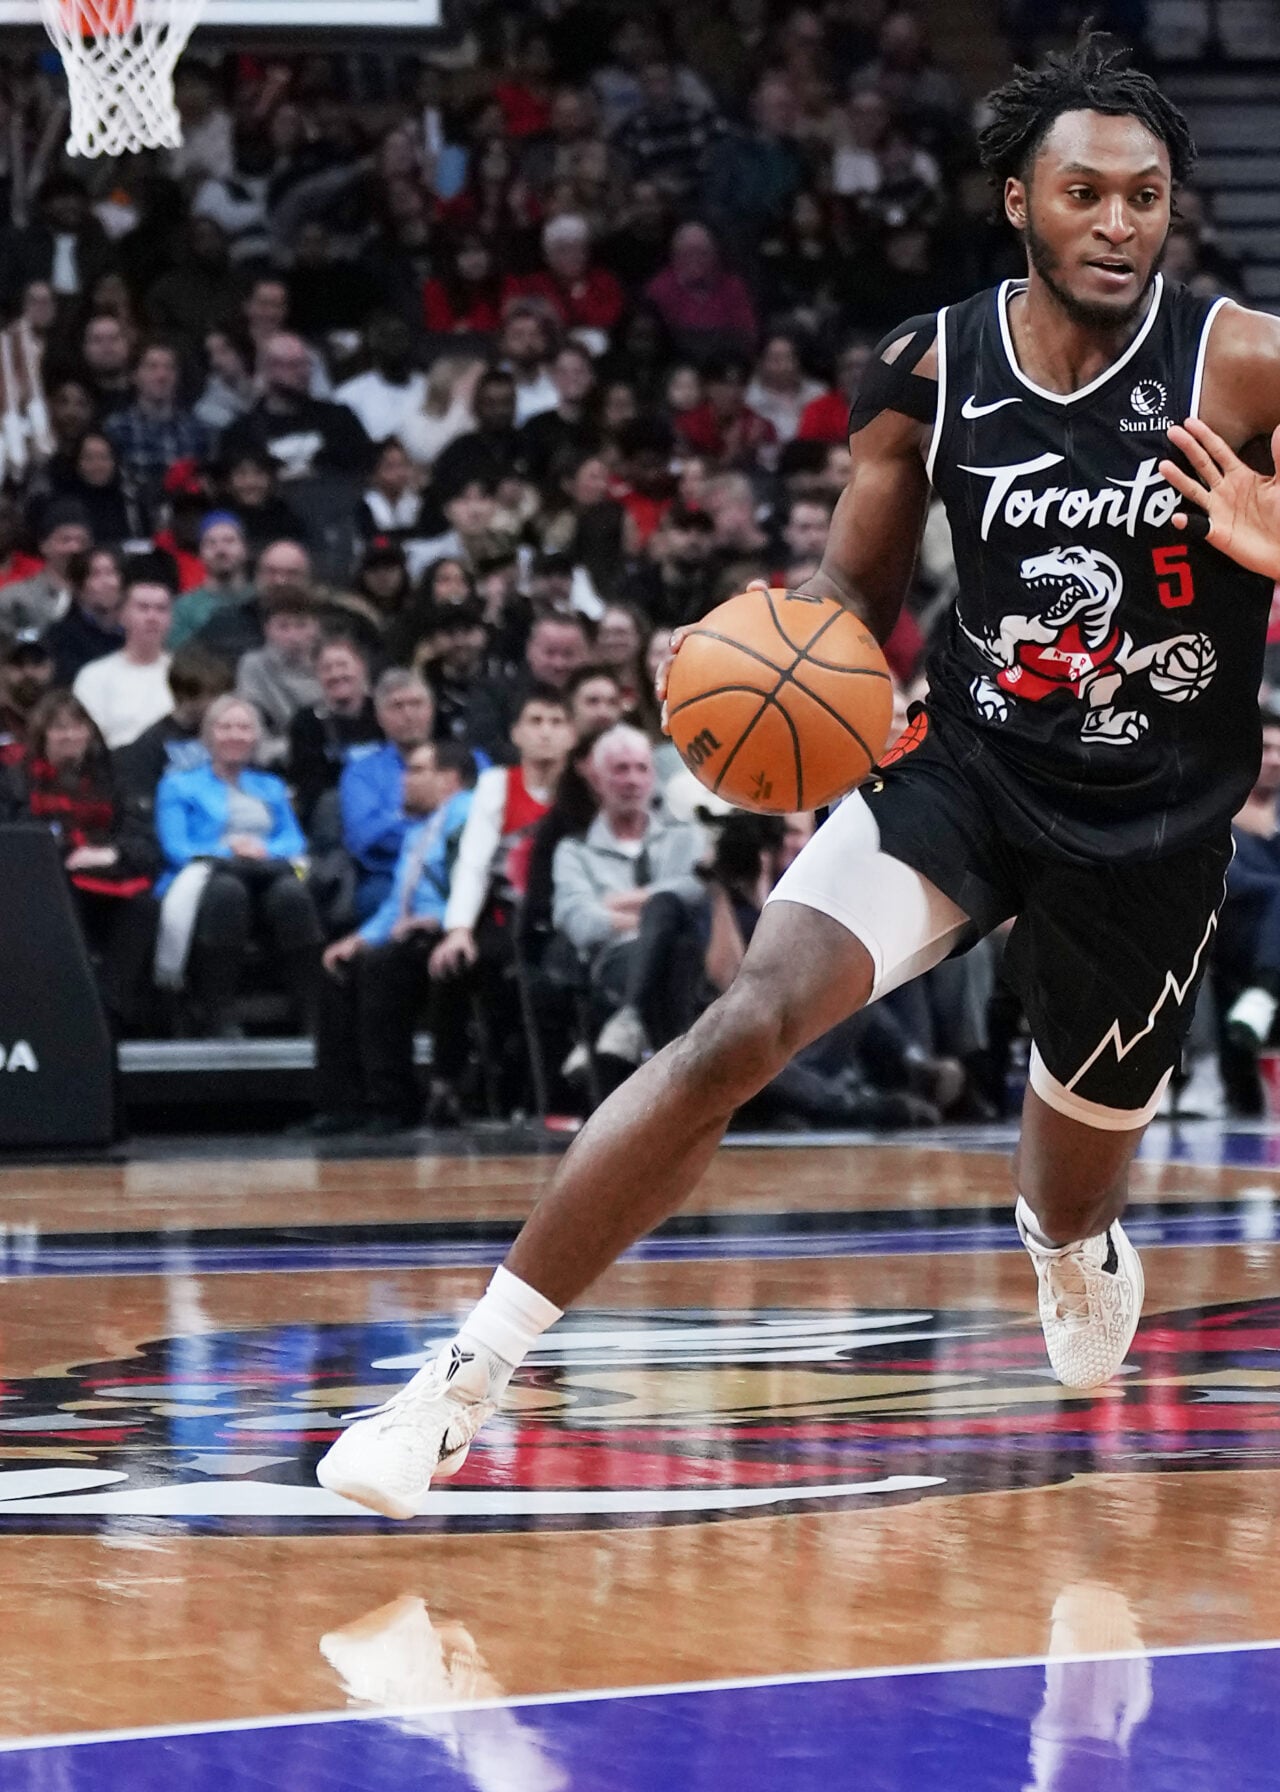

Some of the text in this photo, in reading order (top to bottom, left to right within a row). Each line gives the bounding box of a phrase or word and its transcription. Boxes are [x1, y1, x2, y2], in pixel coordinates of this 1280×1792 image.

[1119, 416, 1174, 432] Sun Life
[957, 452, 1182, 541] Toronto
[1151, 545, 1194, 608] 5
